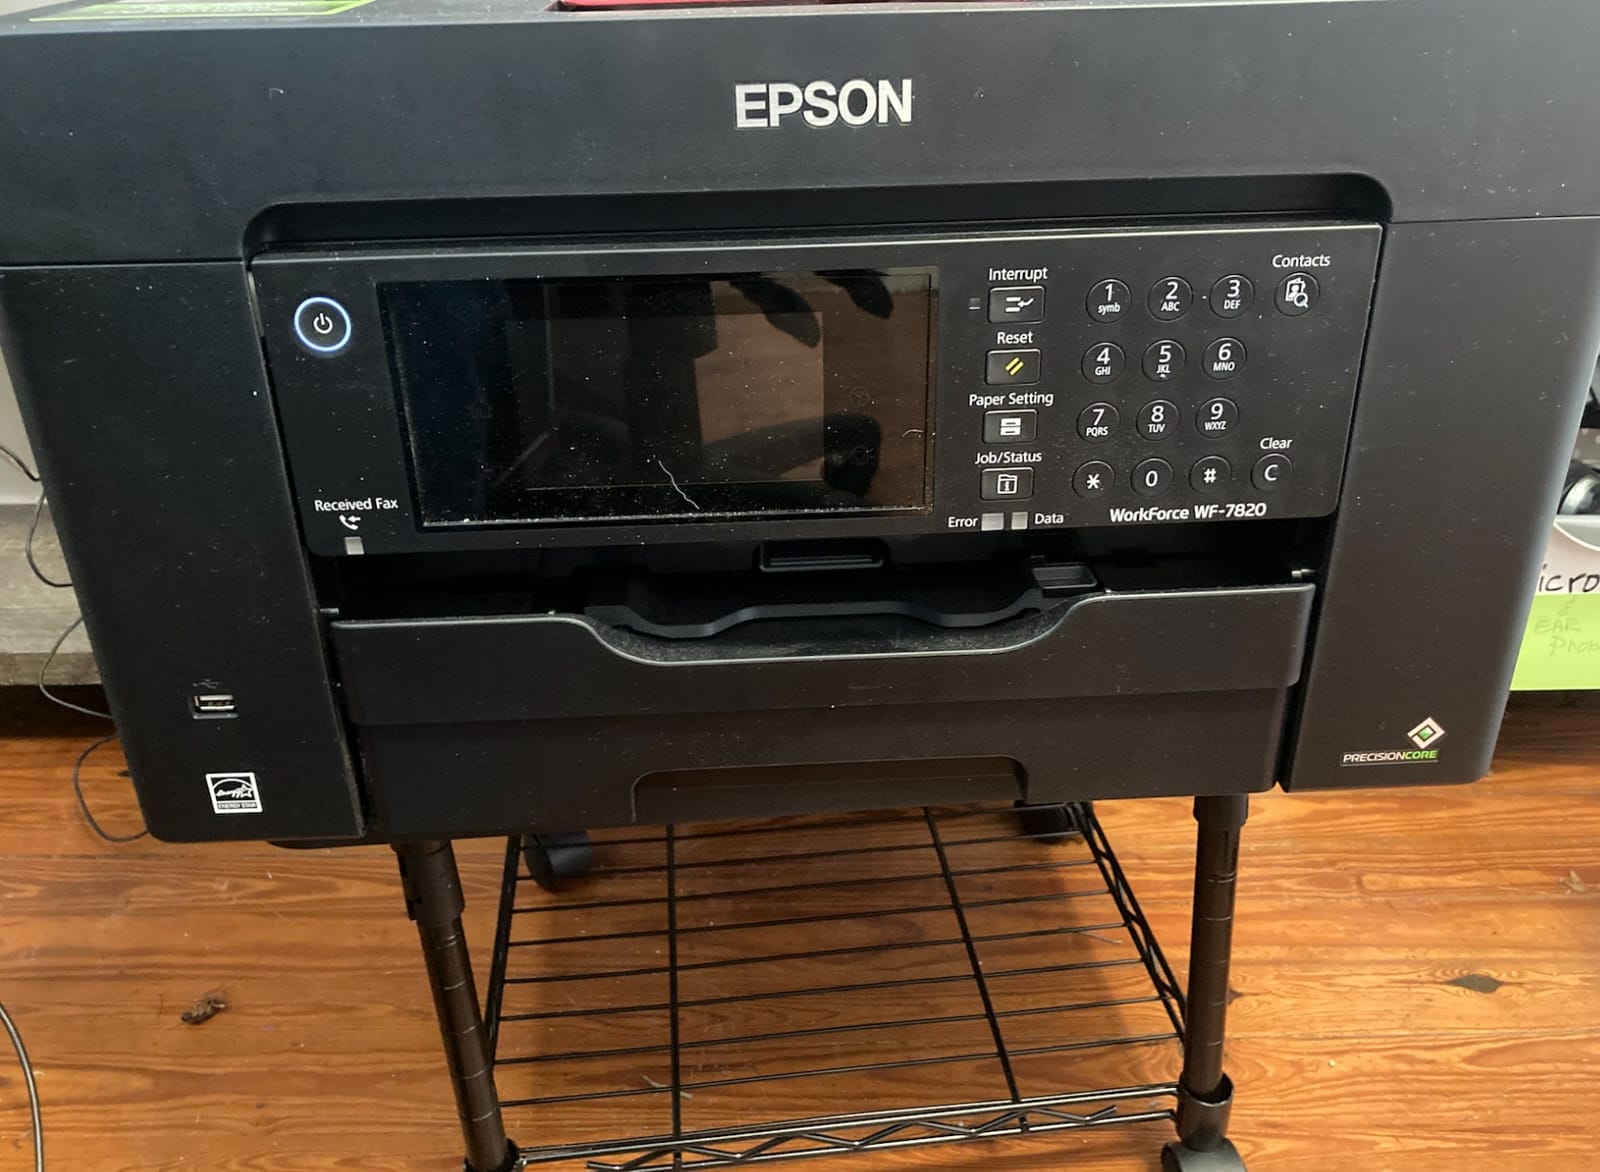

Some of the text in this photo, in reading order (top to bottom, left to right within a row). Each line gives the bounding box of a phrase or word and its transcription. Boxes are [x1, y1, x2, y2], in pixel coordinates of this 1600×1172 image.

[735, 79, 912, 127] EPSON
[1272, 254, 1331, 268] Contacts
[988, 267, 1048, 283] Interrupt
[1105, 283, 1114, 301] 1
[1165, 281, 1178, 299] 2
[1227, 280, 1240, 298] 3
[1098, 302, 1121, 315] symb
[1161, 301, 1180, 311] ABC
[1223, 299, 1241, 309] DEF
[997, 331, 1033, 345] Reset
[1096, 347, 1111, 364] 4
[1159, 345, 1172, 363] 5
[1218, 343, 1232, 361] 6
[1095, 366, 1111, 376] GHI
[1156, 364, 1171, 374] JKL
[1213, 362, 1235, 371] MNO
[969, 392, 1054, 408] Paper Setting
[1093, 408, 1105, 426] 7
[1151, 405, 1164, 422] 8
[1210, 403, 1224, 420] 9
[1086, 426, 1109, 437] PQRS
[1148, 424, 1165, 433] TUV
[1204, 421, 1227, 430] WXYZ
[1260, 437, 1292, 449] Clear
[974, 451, 1042, 465] Job/Status
[1203, 468, 1216, 484] #
[1264, 464, 1278, 481] C
[314, 498, 399, 512] Received Fax
[1034, 513, 1064, 525] Data
[1109, 503, 1267, 522] WorkForce WF-7820
[948, 516, 978, 528] Error
[1343, 750, 1438, 763] PRECISIONCORE
